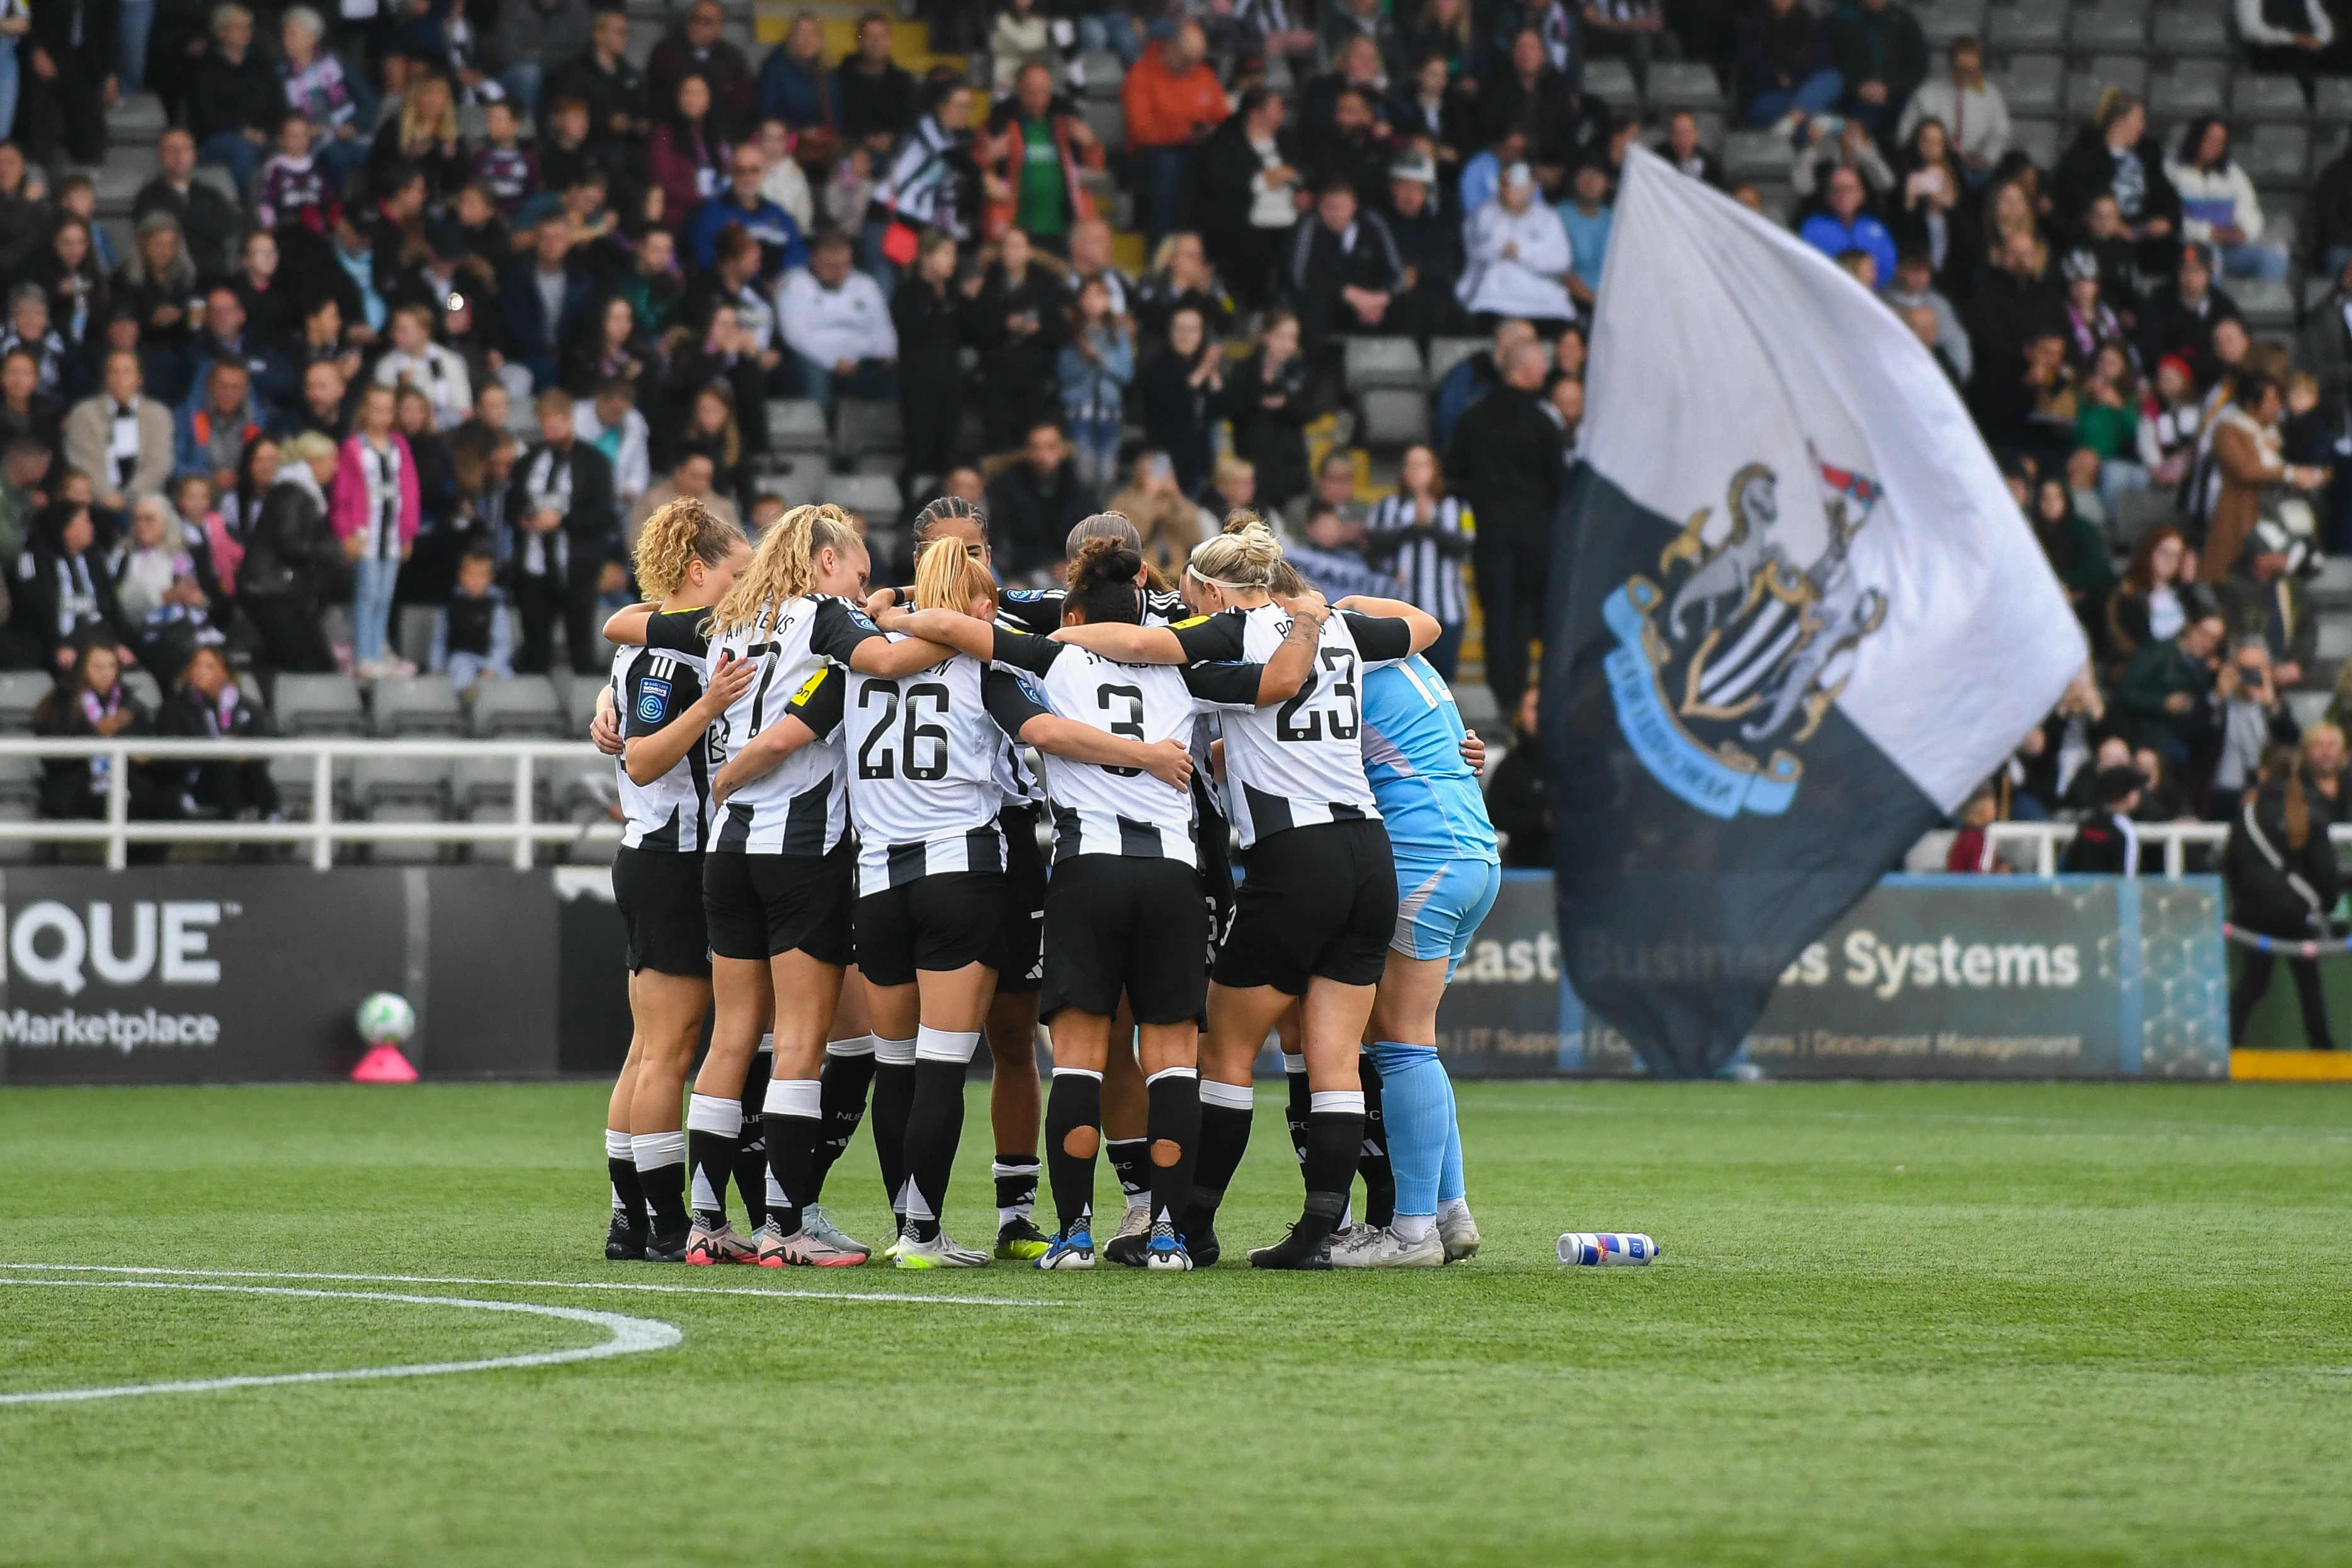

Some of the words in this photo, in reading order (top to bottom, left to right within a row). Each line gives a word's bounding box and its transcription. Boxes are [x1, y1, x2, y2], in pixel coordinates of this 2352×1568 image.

[858, 678, 950, 781] 26
[1097, 683, 1145, 778] 3
[1276, 646, 1360, 742] 23
[0, 899, 220, 996] QUE
[1452, 932, 1560, 984] ast
[1845, 930, 2079, 1000] Systems
[0, 1008, 220, 1054] Marketplace
[1632, 1242, 1642, 1254] 13
